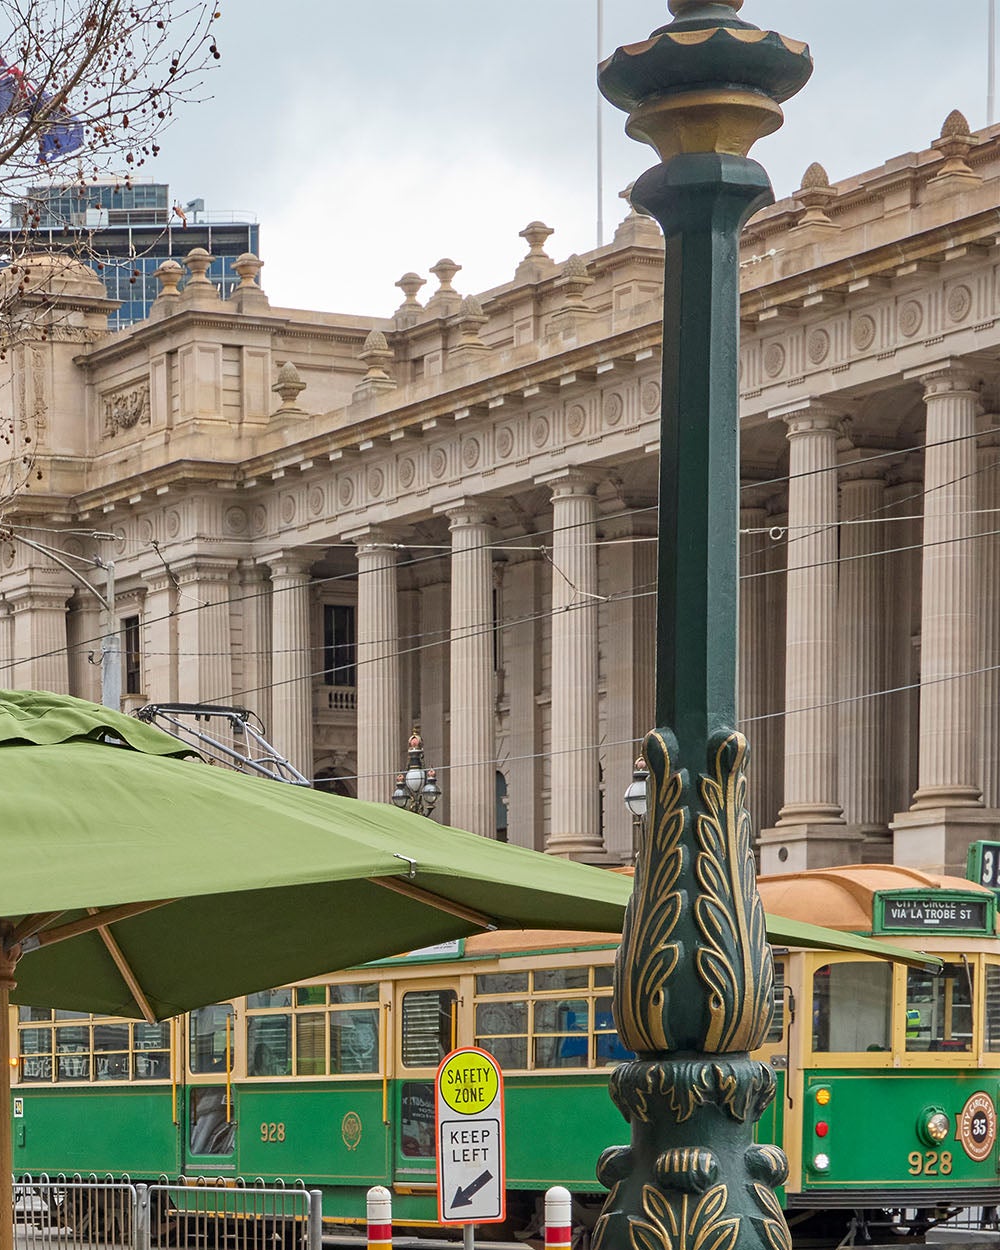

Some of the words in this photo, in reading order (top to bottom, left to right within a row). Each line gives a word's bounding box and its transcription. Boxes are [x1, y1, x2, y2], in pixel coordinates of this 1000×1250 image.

[982, 851, 1000, 883] 3
[891, 908, 907, 919] VIA
[910, 908, 923, 919] LA
[924, 909, 956, 919] TROBE
[960, 909, 972, 920] ST
[447, 1067, 491, 1085] SAFETY
[455, 1087, 485, 1103] ZONE
[963, 1112, 971, 1138] CITY
[969, 1098, 989, 1112] CIRCLE
[972, 1118, 987, 1136] 35
[260, 1122, 286, 1143] 928
[450, 1129, 490, 1145] KEEP
[452, 1148, 489, 1163] LEFT
[907, 1151, 953, 1176] 928
